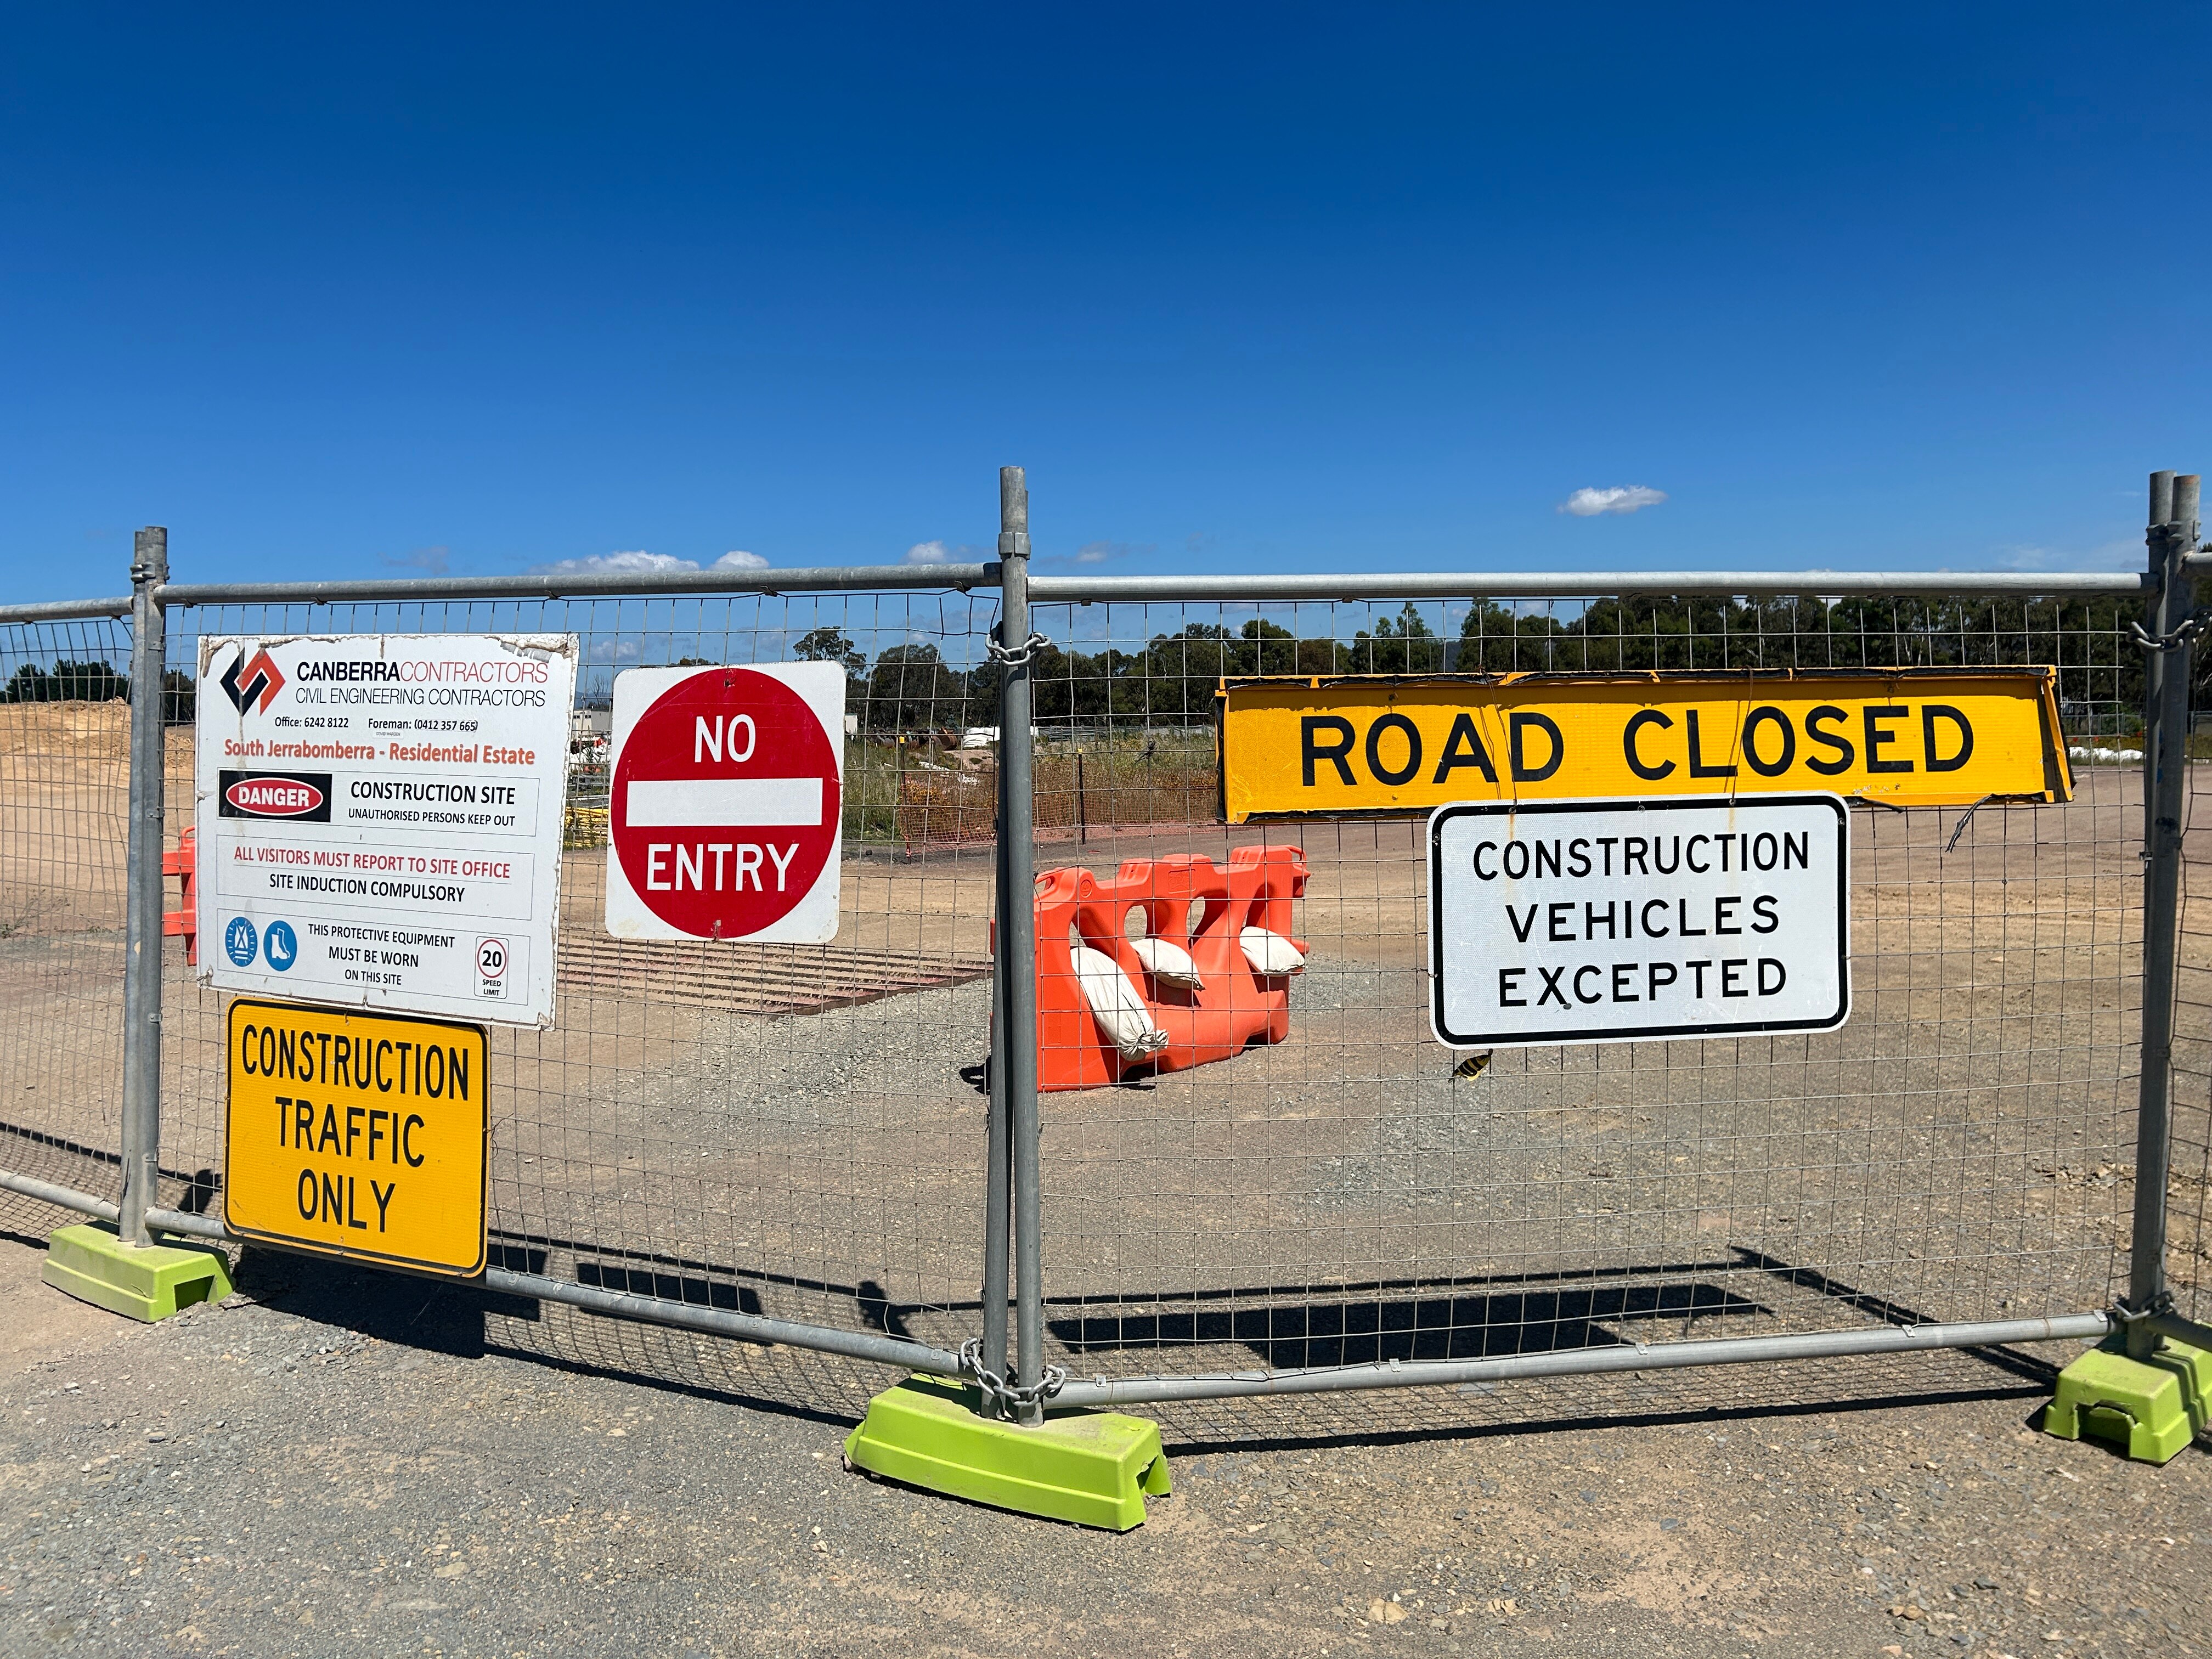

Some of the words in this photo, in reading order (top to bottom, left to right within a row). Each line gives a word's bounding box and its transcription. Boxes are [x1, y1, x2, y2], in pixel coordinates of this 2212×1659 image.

[297, 661, 548, 683] CANBERRACONTRACTORS
[296, 687, 327, 703] CIVIL
[330, 687, 424, 704] ENGINEERING
[428, 688, 546, 707] CONTRACTORS
[275, 716, 302, 726] Office:
[305, 718, 324, 727] 6242
[328, 718, 348, 727] 8122
[369, 719, 411, 729] Foreman:
[415, 719, 438, 729] (0412
[441, 721, 457, 730] 357
[460, 720, 478, 731] 665)
[695, 714, 755, 763] NO
[1301, 713, 1564, 786] ROAD
[1623, 705, 1973, 780] CLOSED
[224, 739, 264, 757] South
[267, 741, 375, 759] Jerrabomberra
[389, 742, 478, 763] Residential
[483, 746, 535, 765] Estate
[239, 787, 309, 807] DANGER
[351, 781, 476, 803] CONSTRUCTION
[481, 787, 515, 804] SITE
[349, 809, 419, 821] UNAUTHORISED
[422, 811, 465, 823] PERSONS
[468, 814, 491, 825] KEEP
[494, 815, 515, 826] OUT
[234, 847, 253, 860] ALL
[257, 848, 309, 864] VISITORS
[314, 851, 350, 867] MUST
[354, 854, 404, 871] REPORT
[408, 857, 426, 872] TO
[430, 859, 458, 874] SITE
[462, 861, 511, 878] OFFICE
[646, 843, 800, 892] ENTRY
[1473, 832, 1808, 881] CONSTRUCTION
[270, 874, 293, 888] SITE
[297, 876, 367, 895] INDUCTION
[370, 881, 465, 902] COMPULSORY
[1505, 895, 1779, 943] VEHICLES
[308, 924, 328, 935] THIS
[332, 926, 389, 941] PROTECTIVE
[393, 932, 455, 947] EQUIPMENT
[329, 946, 360, 961] MUST
[364, 950, 377, 963] BE
[381, 951, 418, 967] WORN
[482, 950, 502, 968] 20
[345, 969, 358, 980] ON
[361, 971, 380, 983] THIS
[383, 974, 401, 985] SITE
[1499, 958, 1786, 1007] EXCEPTED
[242, 1024, 469, 1101] CONSTRUCTION
[275, 1096, 426, 1169] TRAFFIC
[298, 1169, 396, 1233] ONLY
